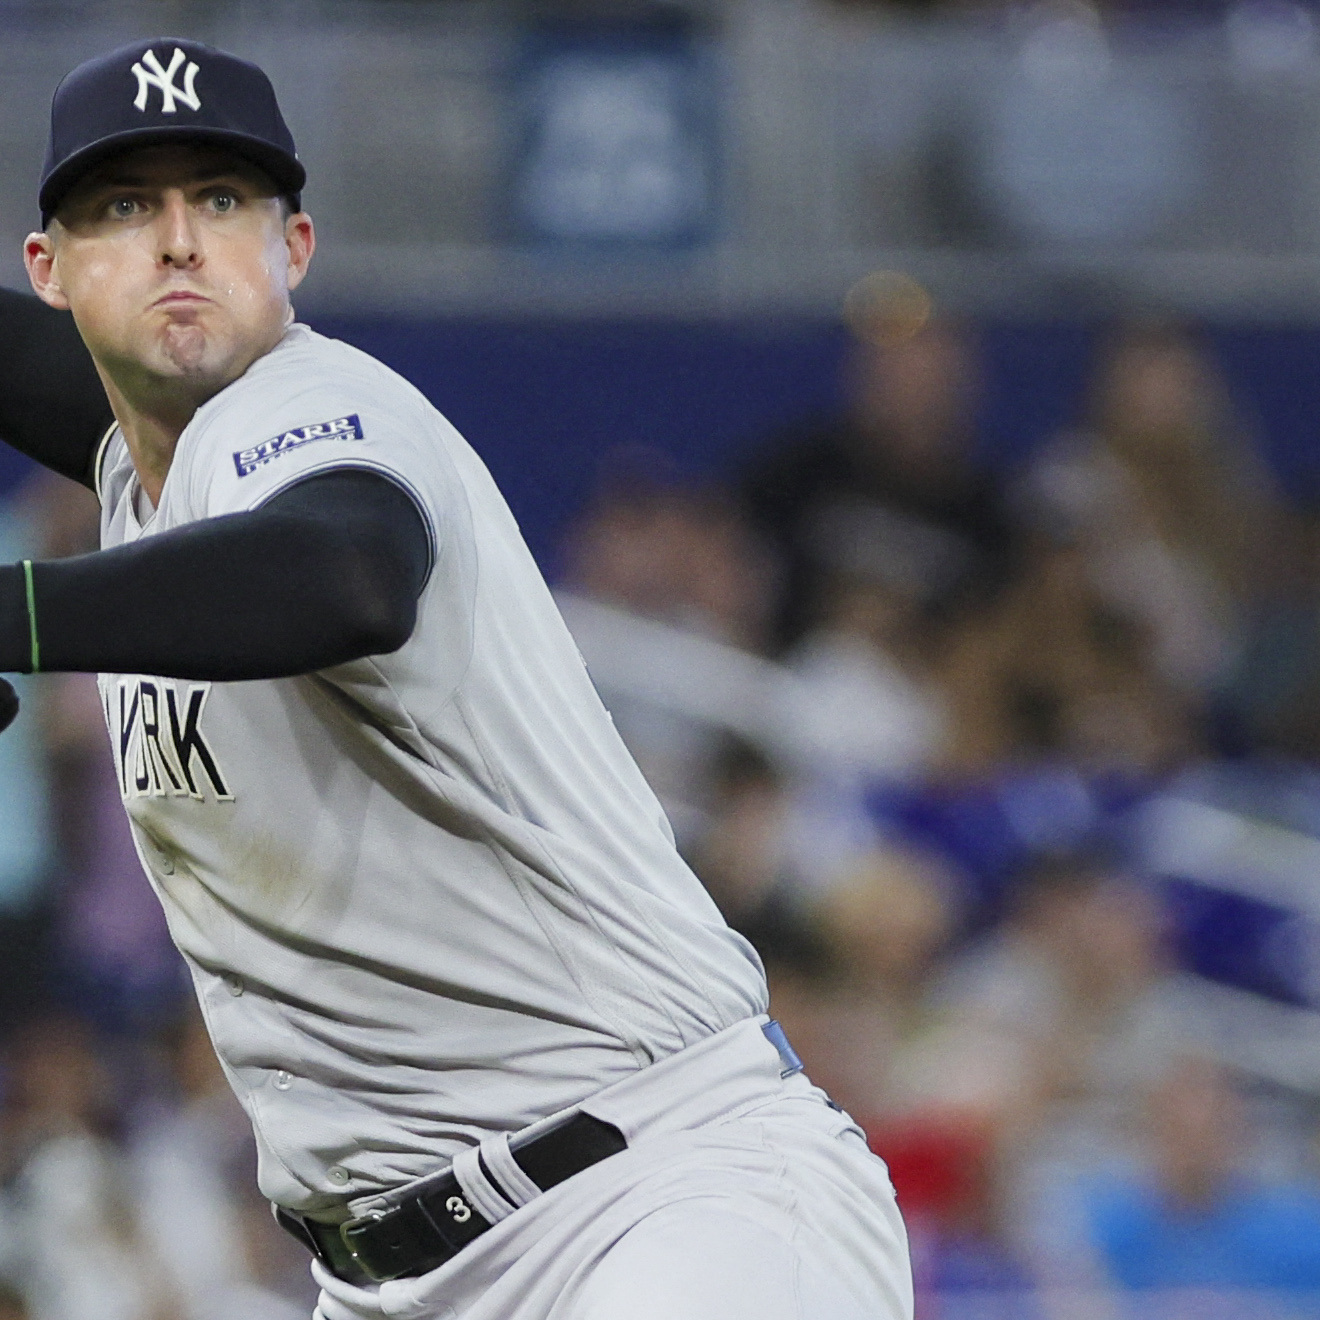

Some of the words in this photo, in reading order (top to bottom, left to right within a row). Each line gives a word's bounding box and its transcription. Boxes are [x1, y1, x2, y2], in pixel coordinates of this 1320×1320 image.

[131, 48, 201, 113] NY
[240, 418, 356, 464] STARR
[446, 1194, 474, 1222] 3
